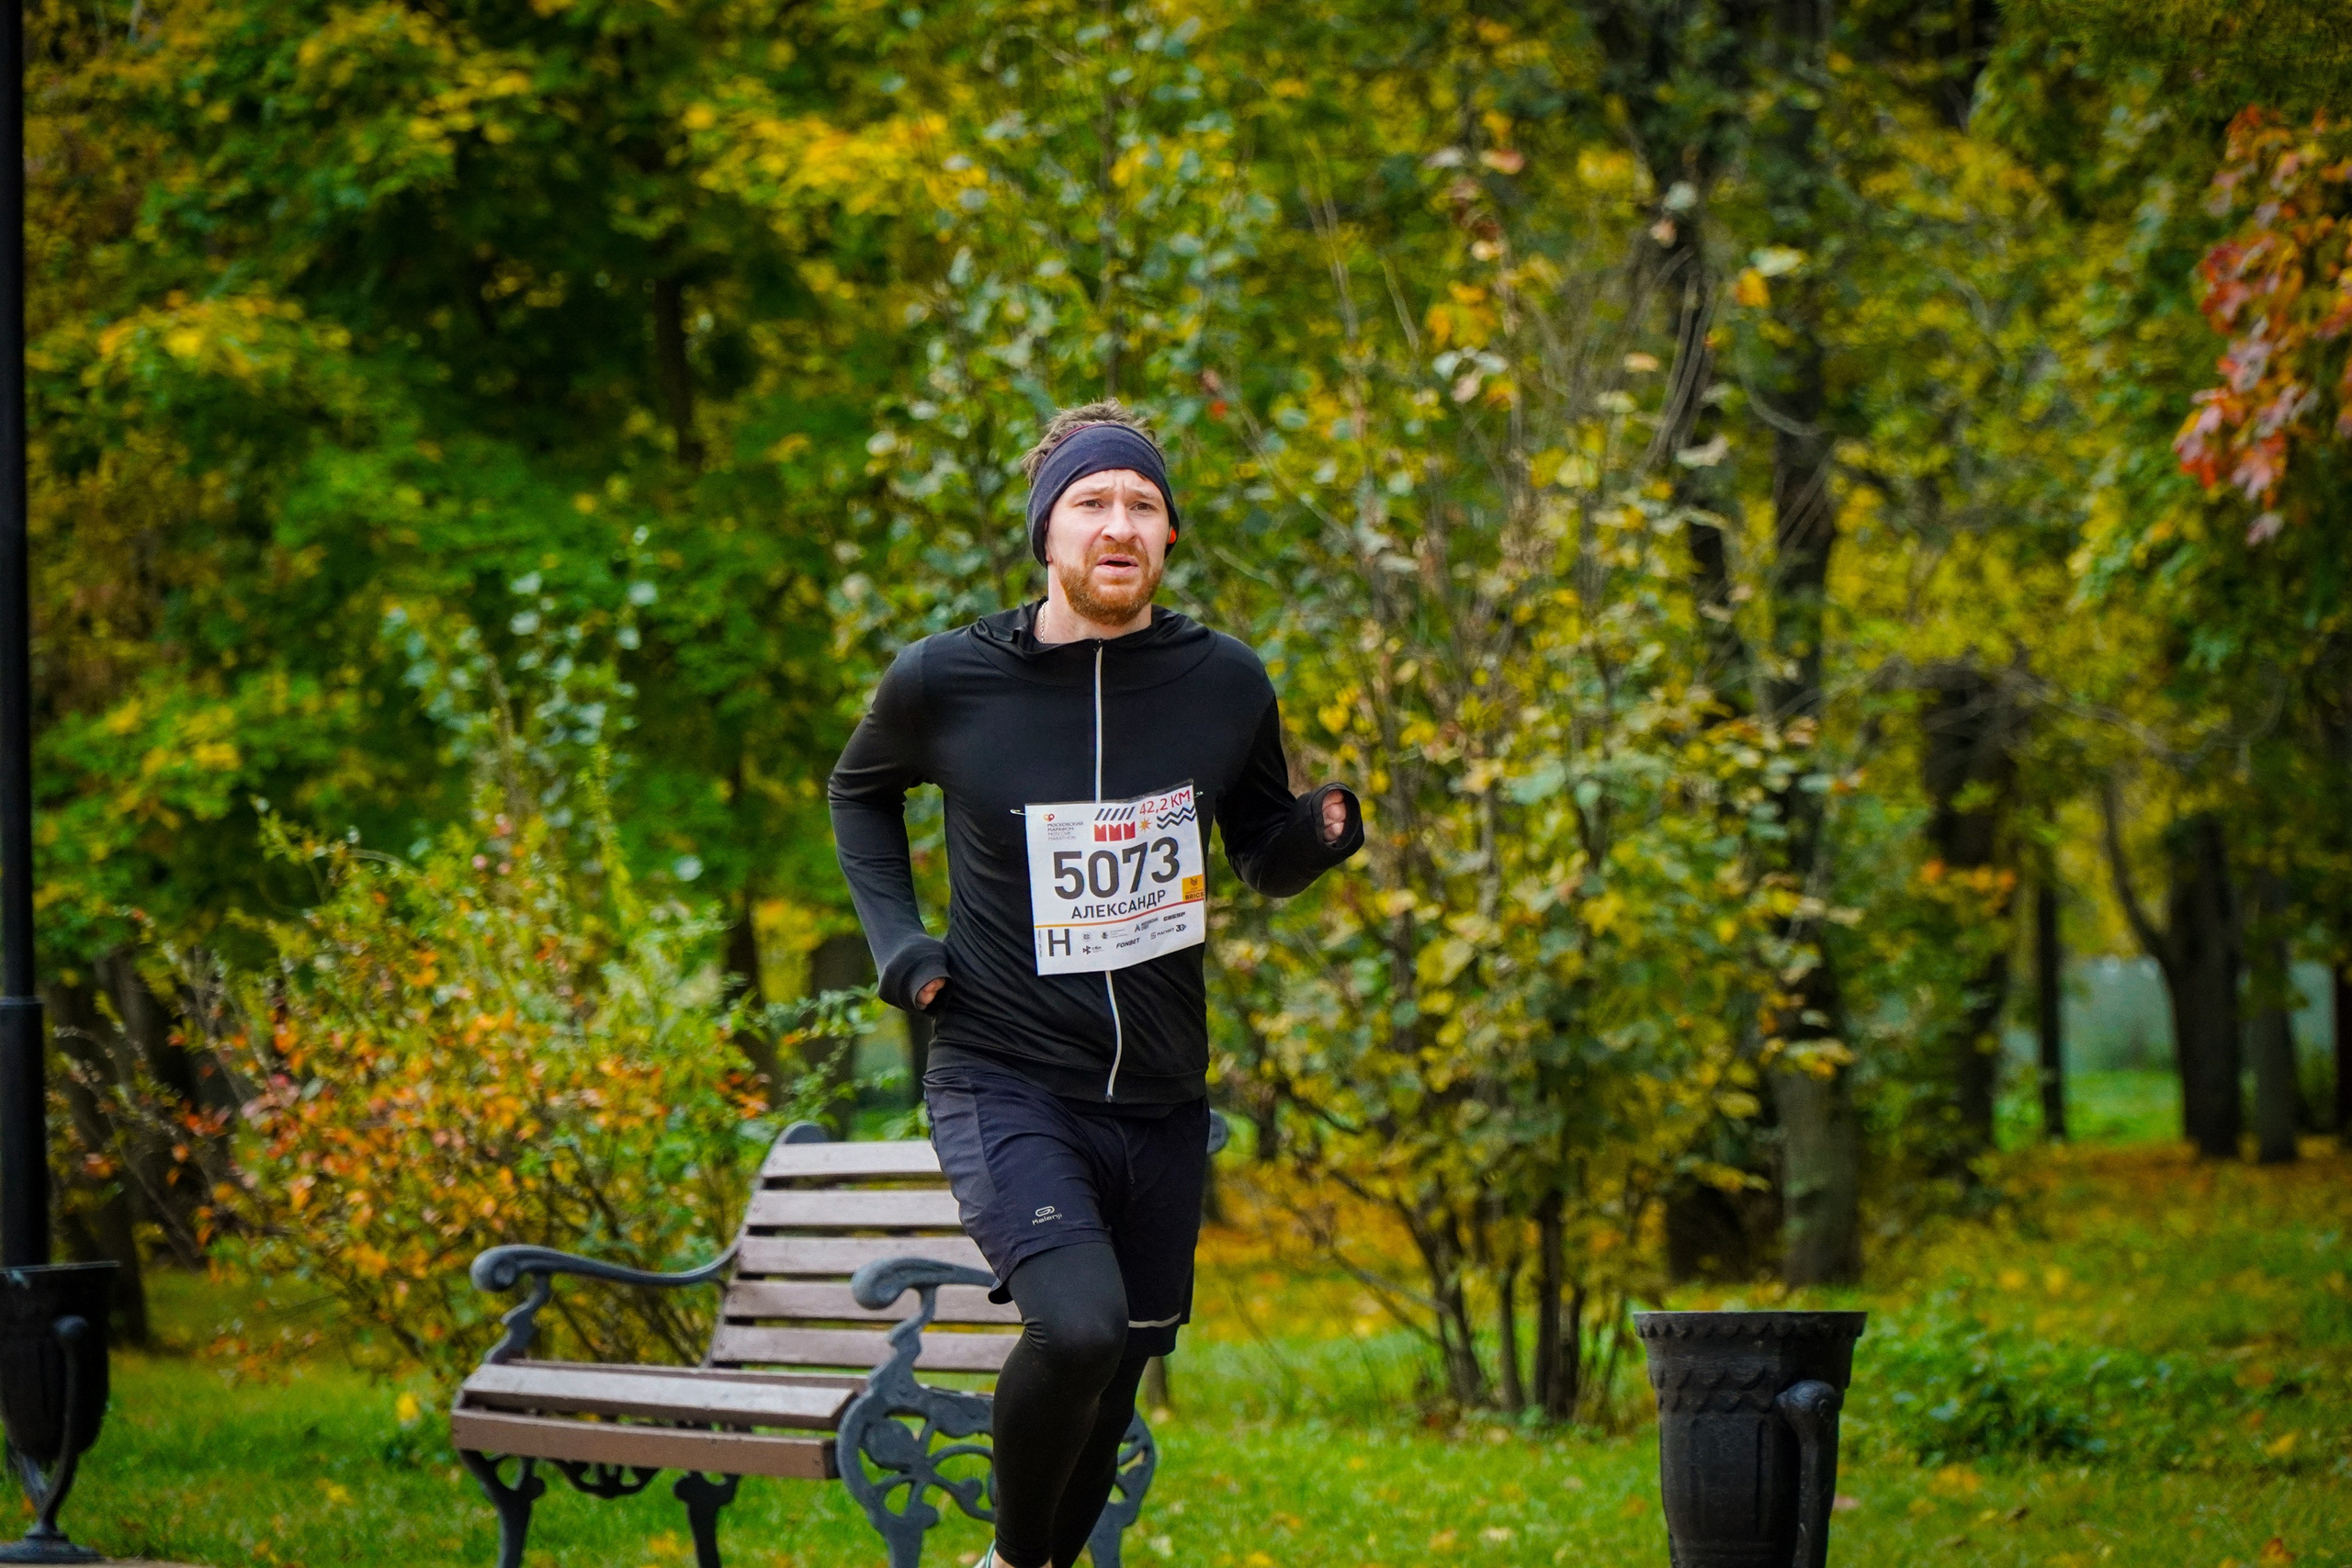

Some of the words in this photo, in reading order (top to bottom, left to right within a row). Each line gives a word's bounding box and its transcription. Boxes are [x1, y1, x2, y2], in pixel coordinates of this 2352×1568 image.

[1139, 797, 1169, 815] 42,2
[1053, 836, 1181, 900] 5073
[1071, 889, 1167, 919] АЛЕКСАНДР
[1115, 937, 1140, 949] FONBET
[1032, 1213, 1062, 1225] Kalenji
